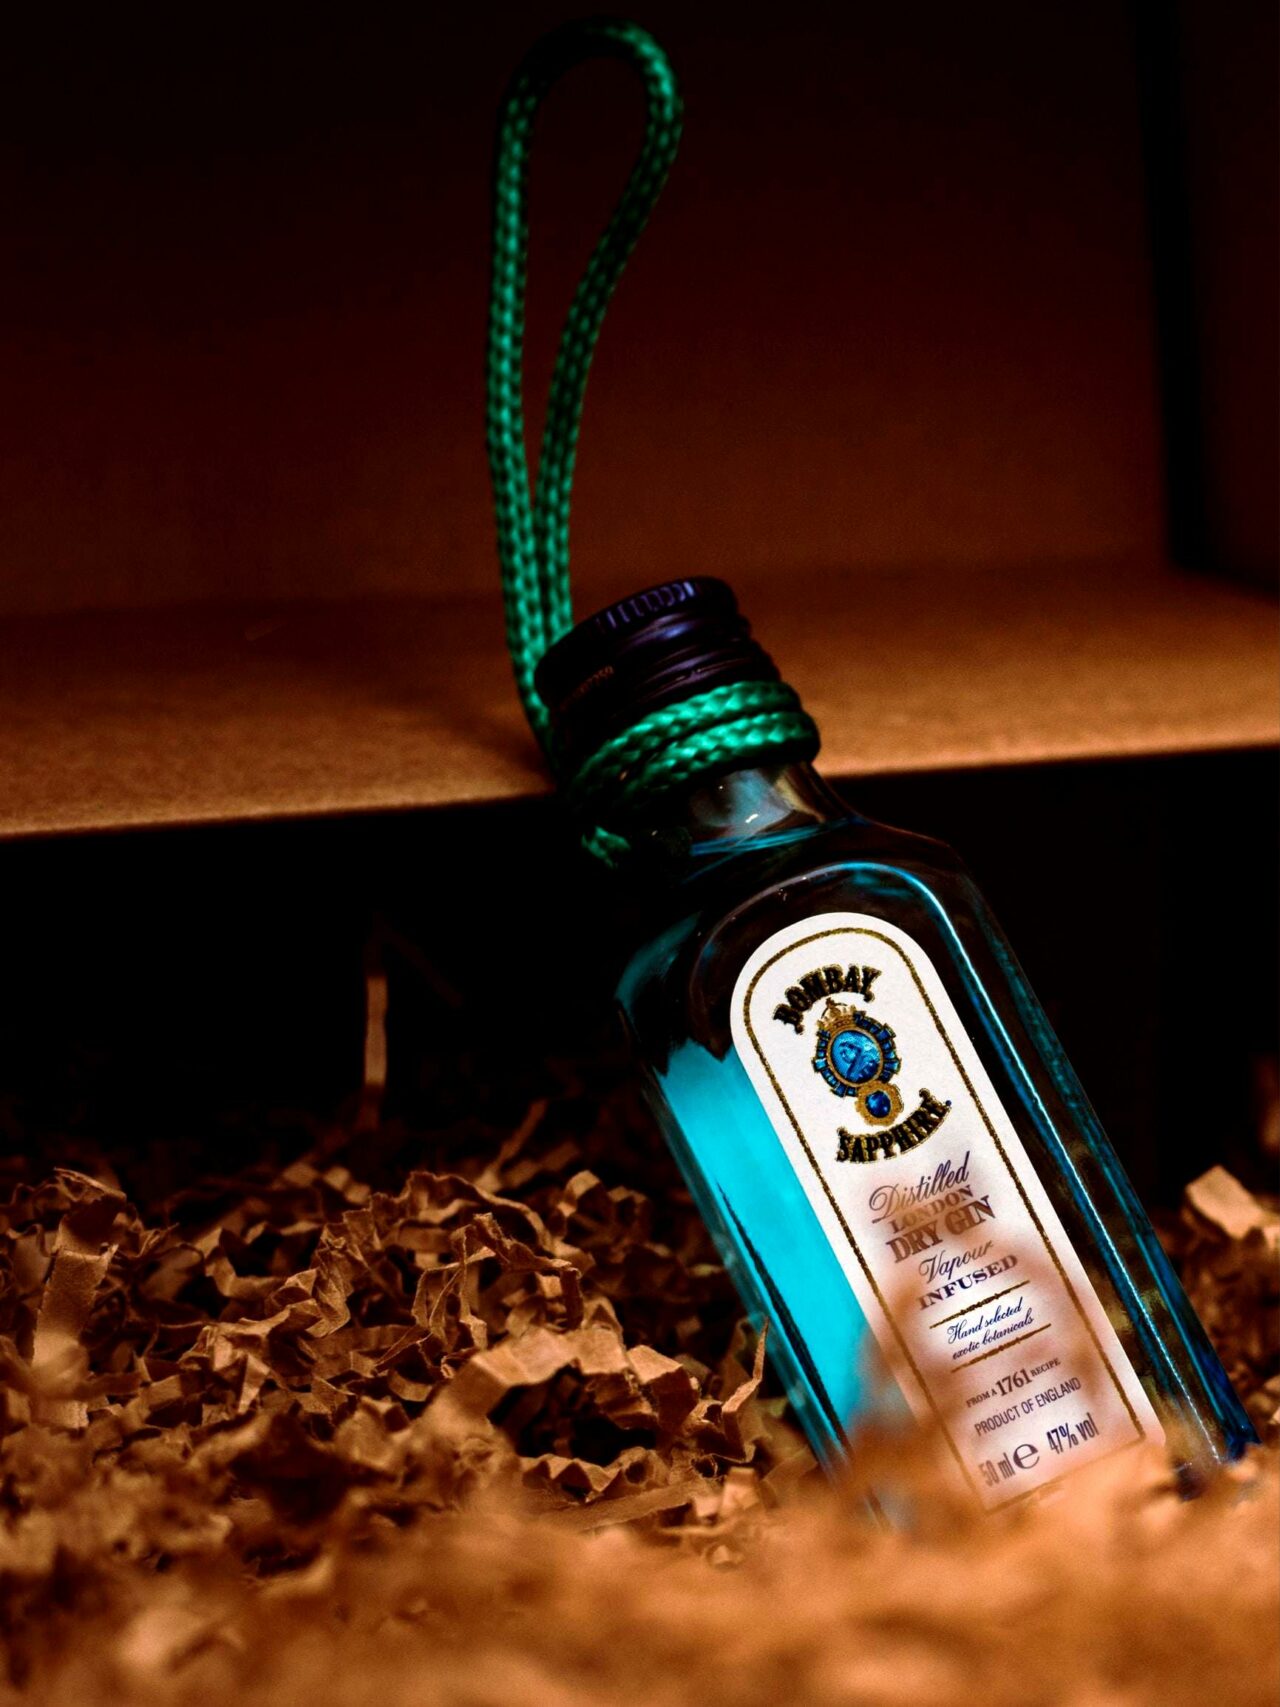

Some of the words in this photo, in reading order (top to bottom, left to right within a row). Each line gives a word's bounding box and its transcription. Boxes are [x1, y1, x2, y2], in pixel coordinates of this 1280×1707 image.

[773, 963, 882, 1035] BOMBAY
[836, 1087, 951, 1164] SAPPHIRE
[869, 1151, 971, 1224] Distilled
[888, 1184, 975, 1234] LONDON
[886, 1220, 943, 1264] DRY
[945, 1195, 997, 1235] GIN
[917, 1254, 1018, 1310] INFUSED
[918, 1240, 995, 1284] Vapour
[947, 1313, 984, 1344] Hand
[985, 1296, 1023, 1327] selected
[952, 1340, 980, 1360] exotic
[983, 1308, 1034, 1346] botanicals
[966, 1392, 991, 1408] FROM
[991, 1389, 998, 1399] A
[997, 1369, 1033, 1396] 1761
[1031, 1357, 1061, 1377] RECIPE
[974, 1405, 1021, 1436] PRODUCT
[1022, 1397, 1035, 1415] OF
[1036, 1376, 1082, 1409] ENGLAND
[979, 1459, 999, 1487] 50
[999, 1451, 1015, 1480] ml
[1046, 1422, 1079, 1455] 47%
[1077, 1412, 1100, 1446] vol
